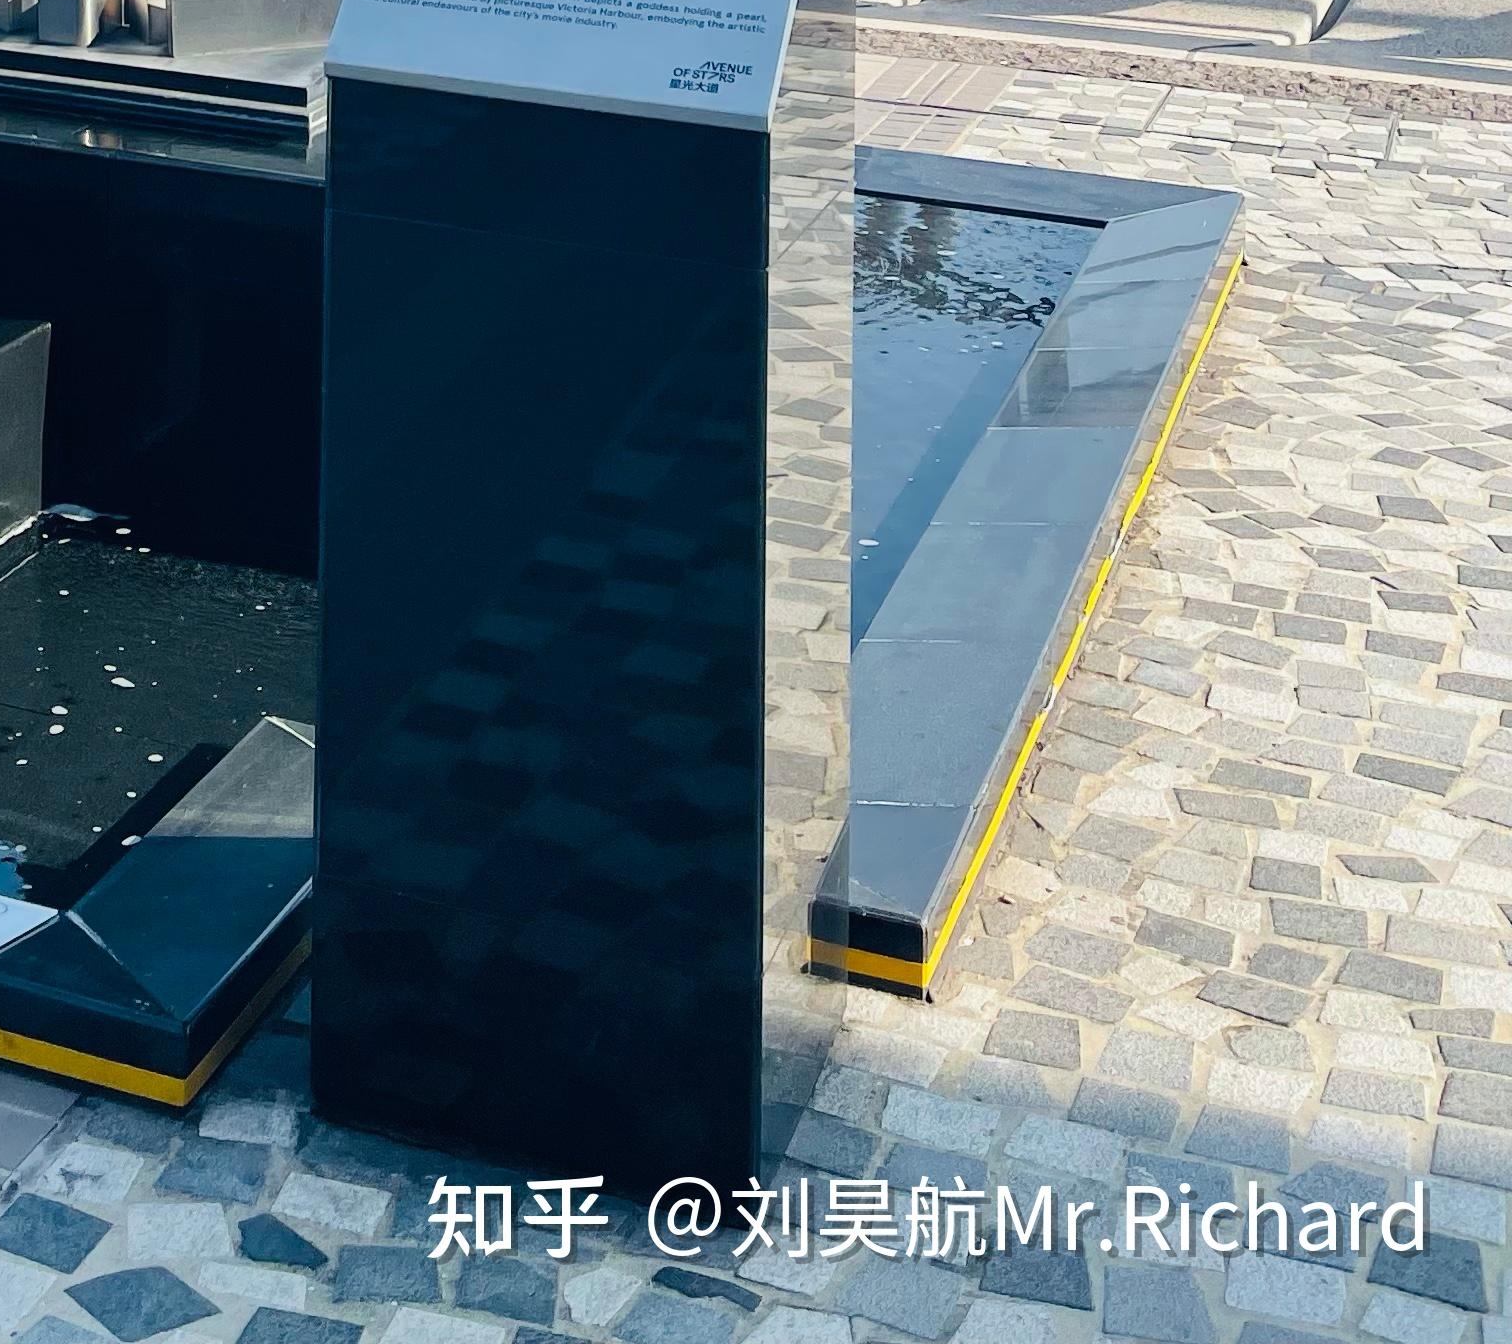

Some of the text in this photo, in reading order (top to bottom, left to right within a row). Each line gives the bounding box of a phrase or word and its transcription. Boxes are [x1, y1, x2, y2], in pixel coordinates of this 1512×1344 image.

[421, 0, 478, 11] endeavours
[494, 7, 511, 15] the
[541, 13, 572, 22] movie
[557, 3, 597, 14] Victoria
[647, 13, 705, 28] embodying
[707, 20, 724, 28] the
[728, 22, 764, 32] artistic
[636, 1, 679, 13] goddess
[683, 6, 722, 18] holding
[673, 67, 690, 78] OF
[699, 61, 753, 75] AVENUE
